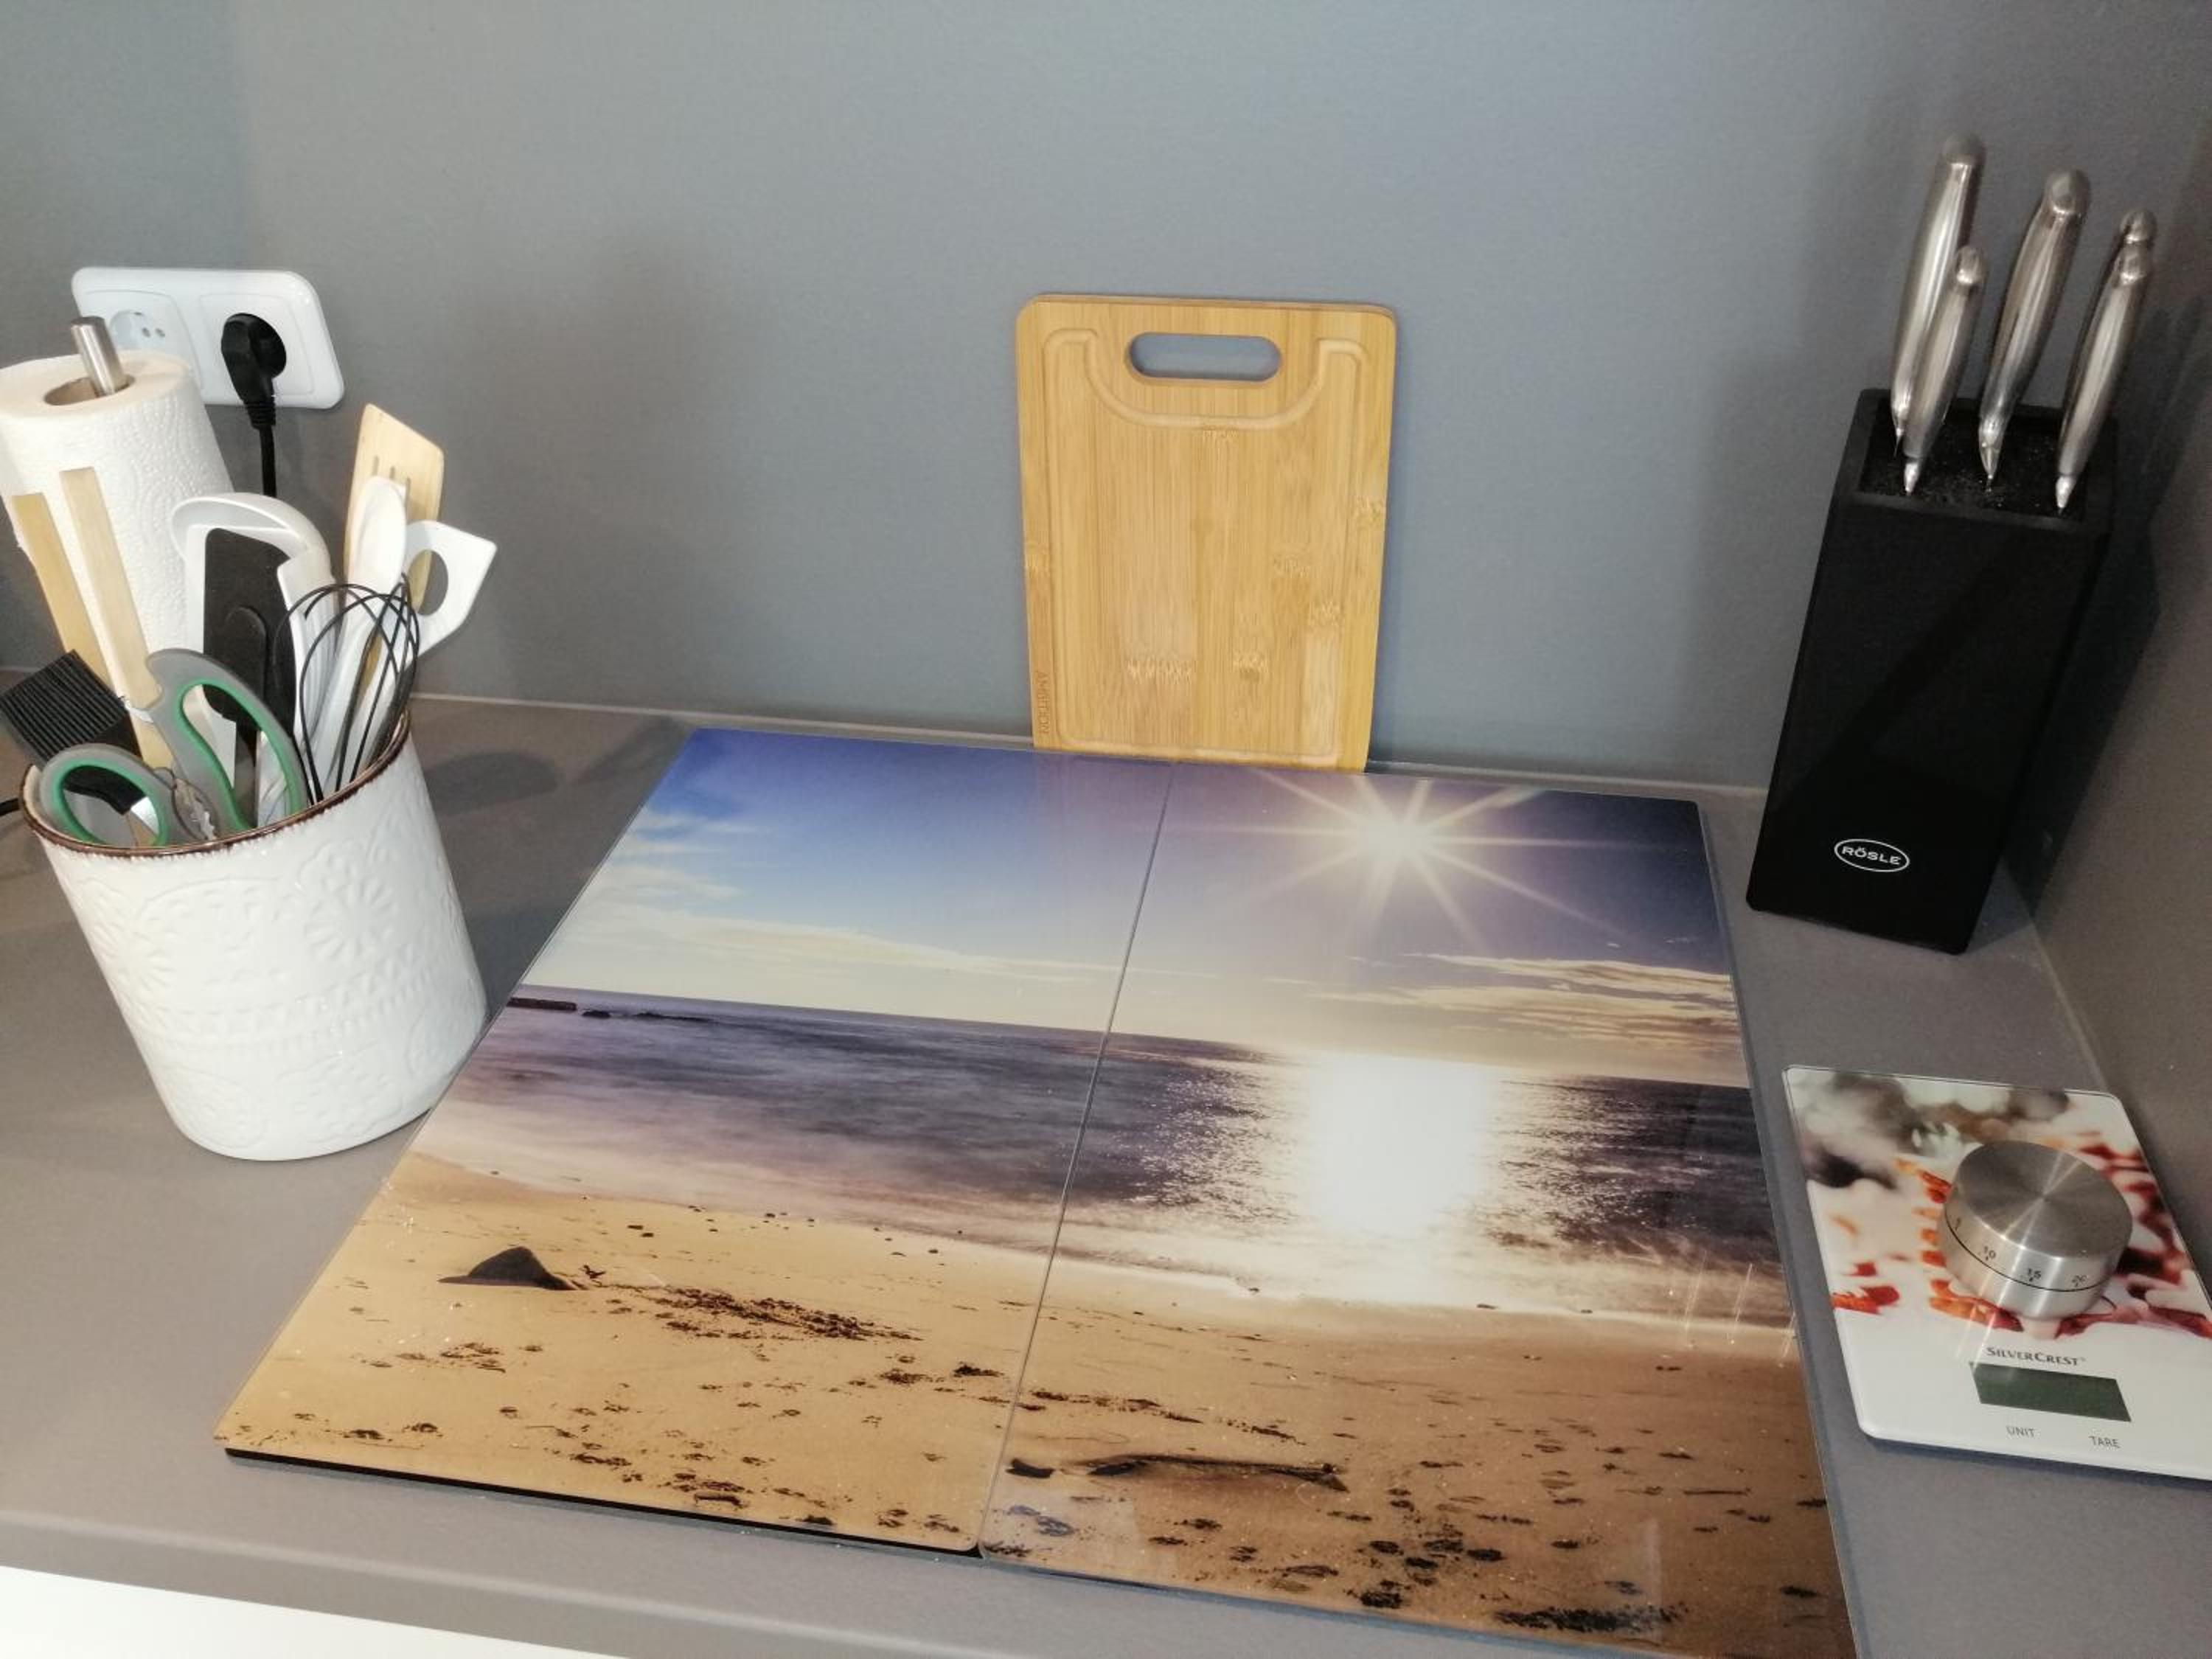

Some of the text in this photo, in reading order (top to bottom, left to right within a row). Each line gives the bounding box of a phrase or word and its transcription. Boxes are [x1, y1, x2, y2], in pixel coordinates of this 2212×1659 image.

[1842, 846, 1902, 865] RÖSLE
[1983, 1245, 1997, 1260] 10
[2006, 1425, 2121, 1449] UNIT TARE
